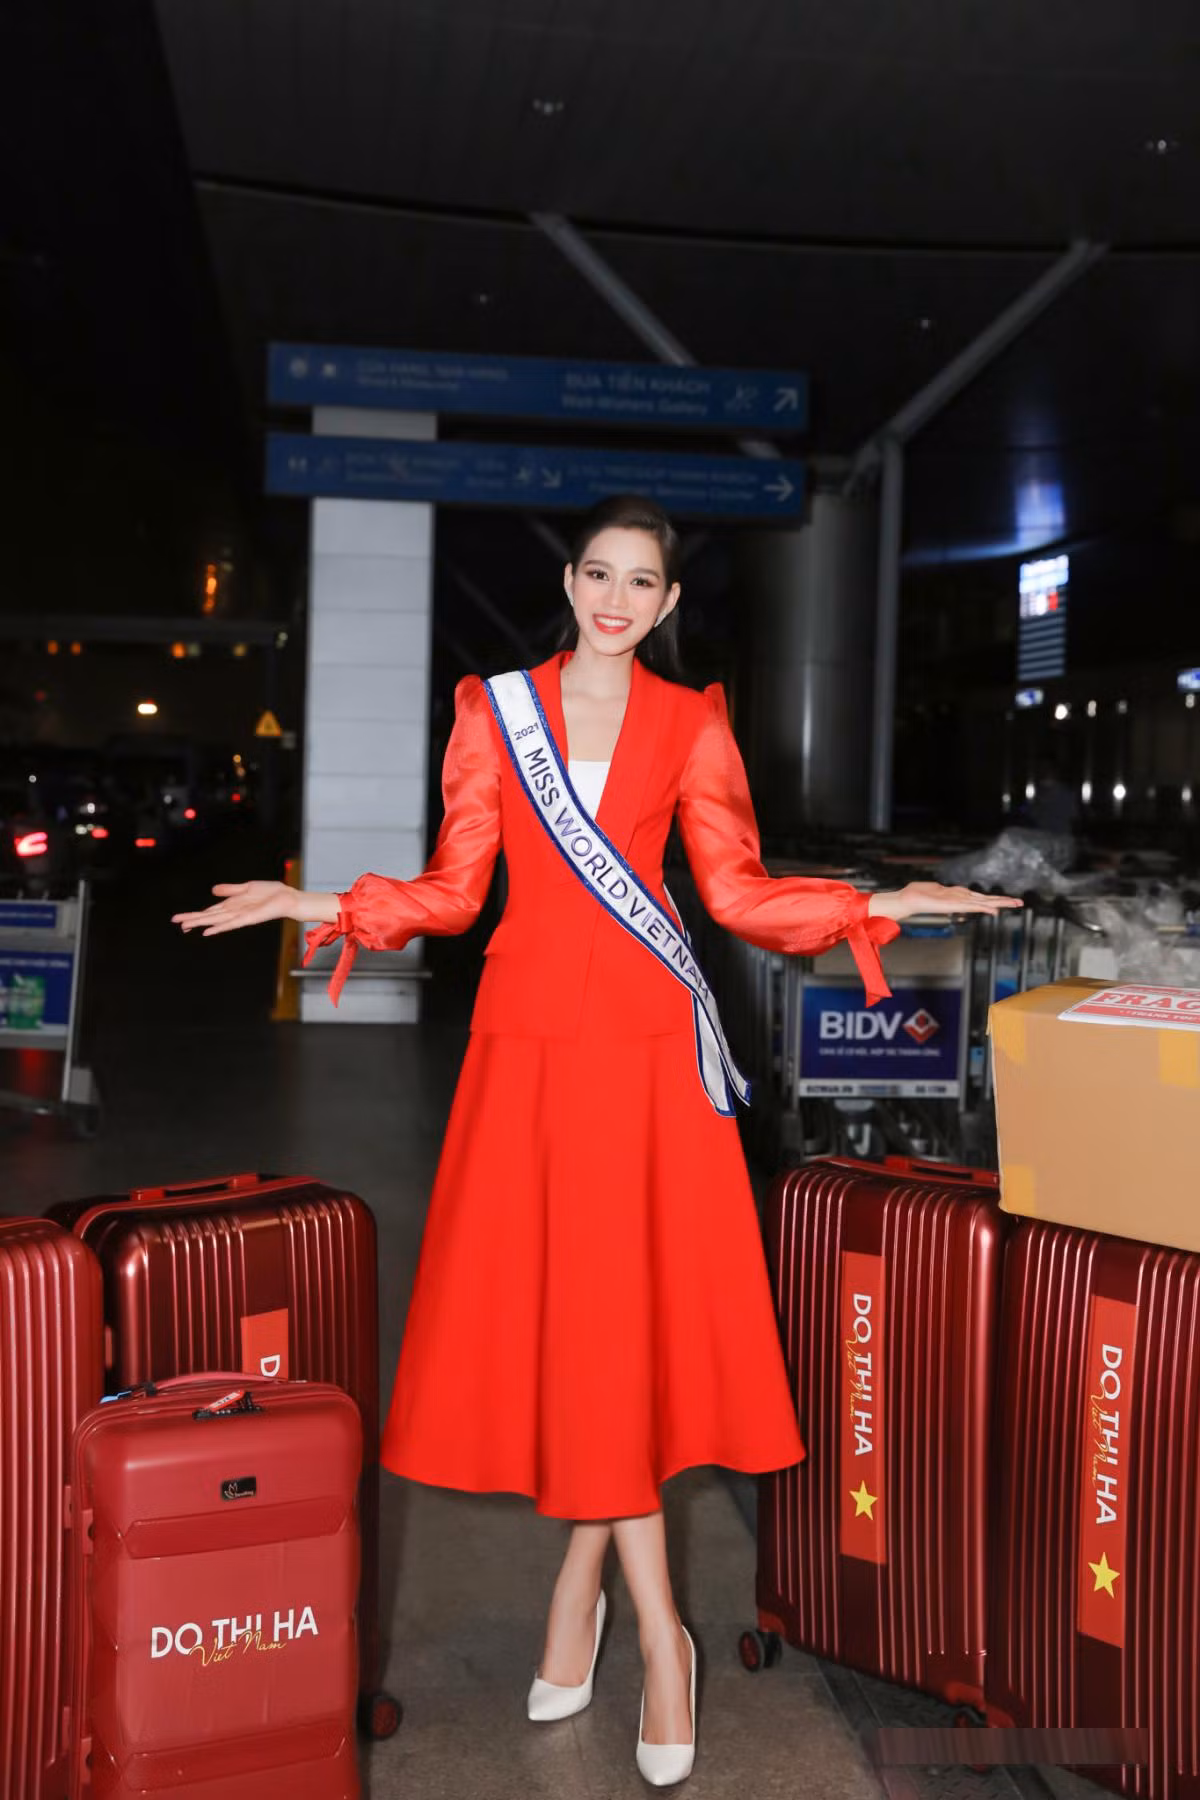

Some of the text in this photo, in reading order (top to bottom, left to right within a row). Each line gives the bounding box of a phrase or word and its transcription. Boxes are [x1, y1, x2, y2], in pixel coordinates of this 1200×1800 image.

[514, 722, 540, 740] 2021
[524, 747, 560, 807] MISS
[554, 807, 628, 900] WORLD
[819, 1011, 903, 1040] BIDV
[852, 1293, 873, 1456] DO THI HA
[1096, 1344, 1123, 1525] DO THI HA
[151, 1606, 319, 1658] DO THI HA
